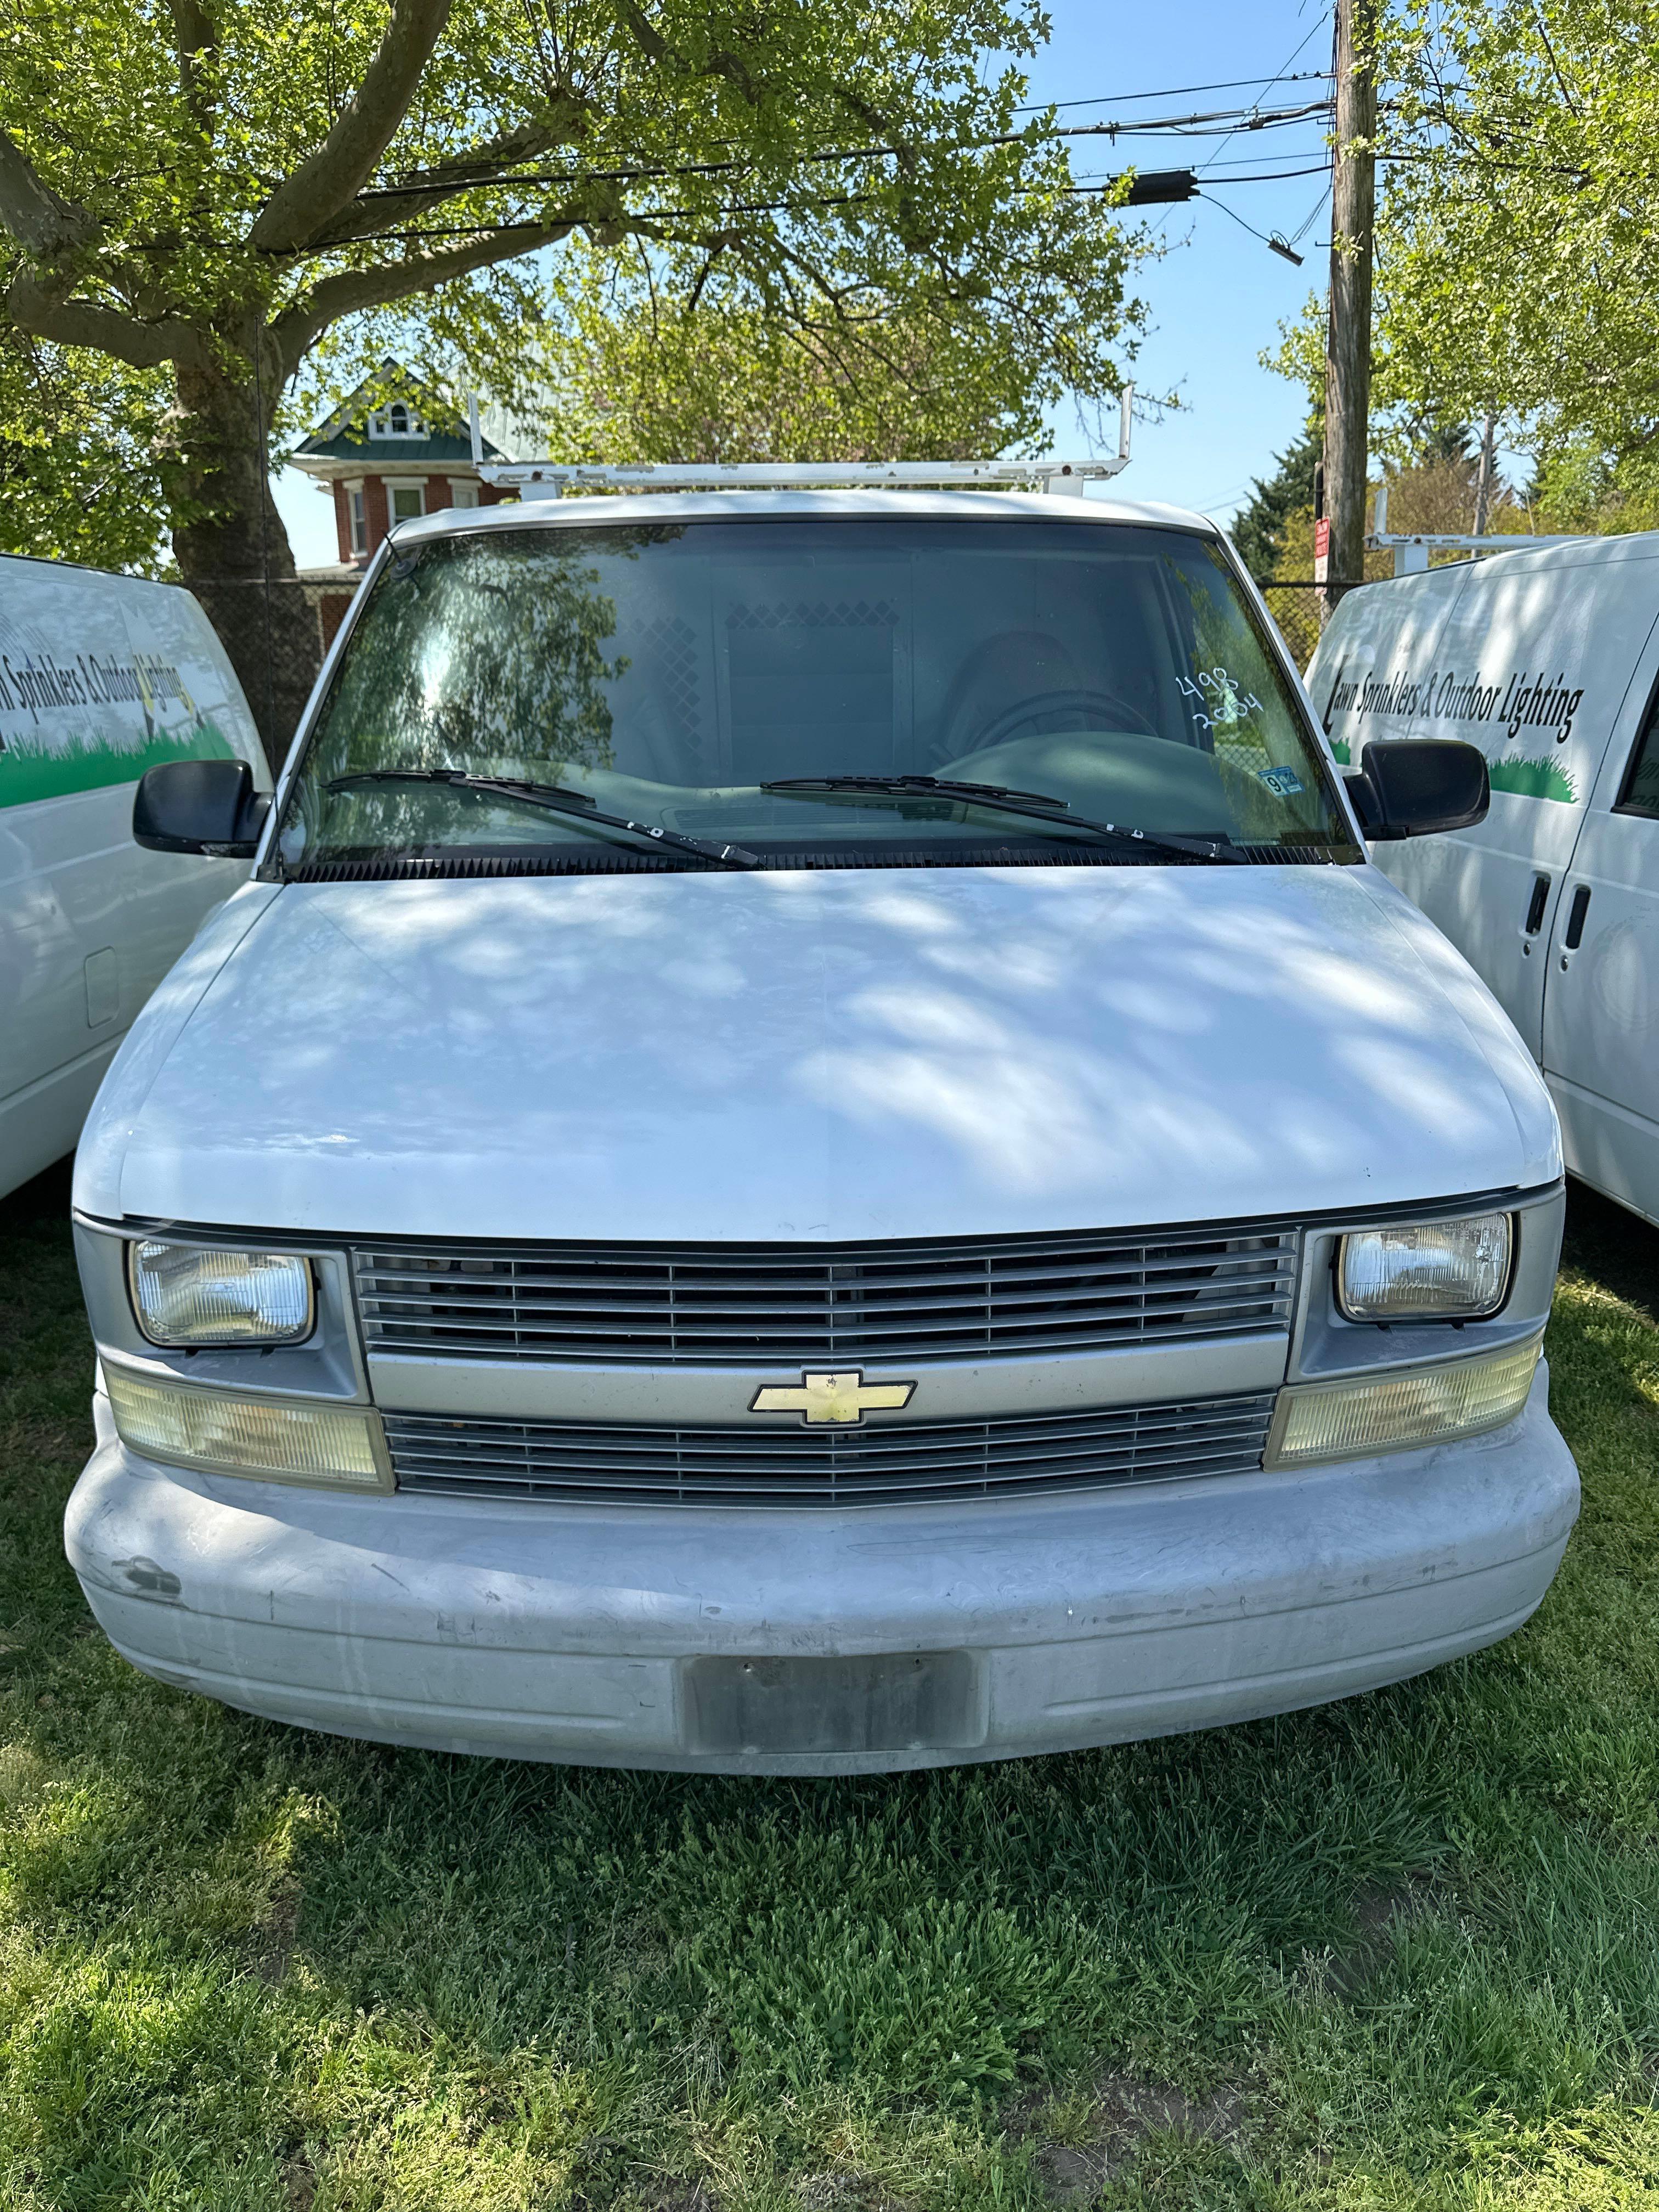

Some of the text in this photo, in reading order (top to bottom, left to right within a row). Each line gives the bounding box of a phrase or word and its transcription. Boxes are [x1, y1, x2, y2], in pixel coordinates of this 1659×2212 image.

[3, 654, 88, 725] Sprinklers
[76, 654, 103, 704] &
[89, 654, 145, 703] Outdoor
[1175, 667, 1238, 701] 498
[1323, 654, 1585, 743] Lawn Sprinklers & Outdoor Lighting
[1192, 693, 1264, 730] 2004
[1267, 777, 1282, 792] 9
